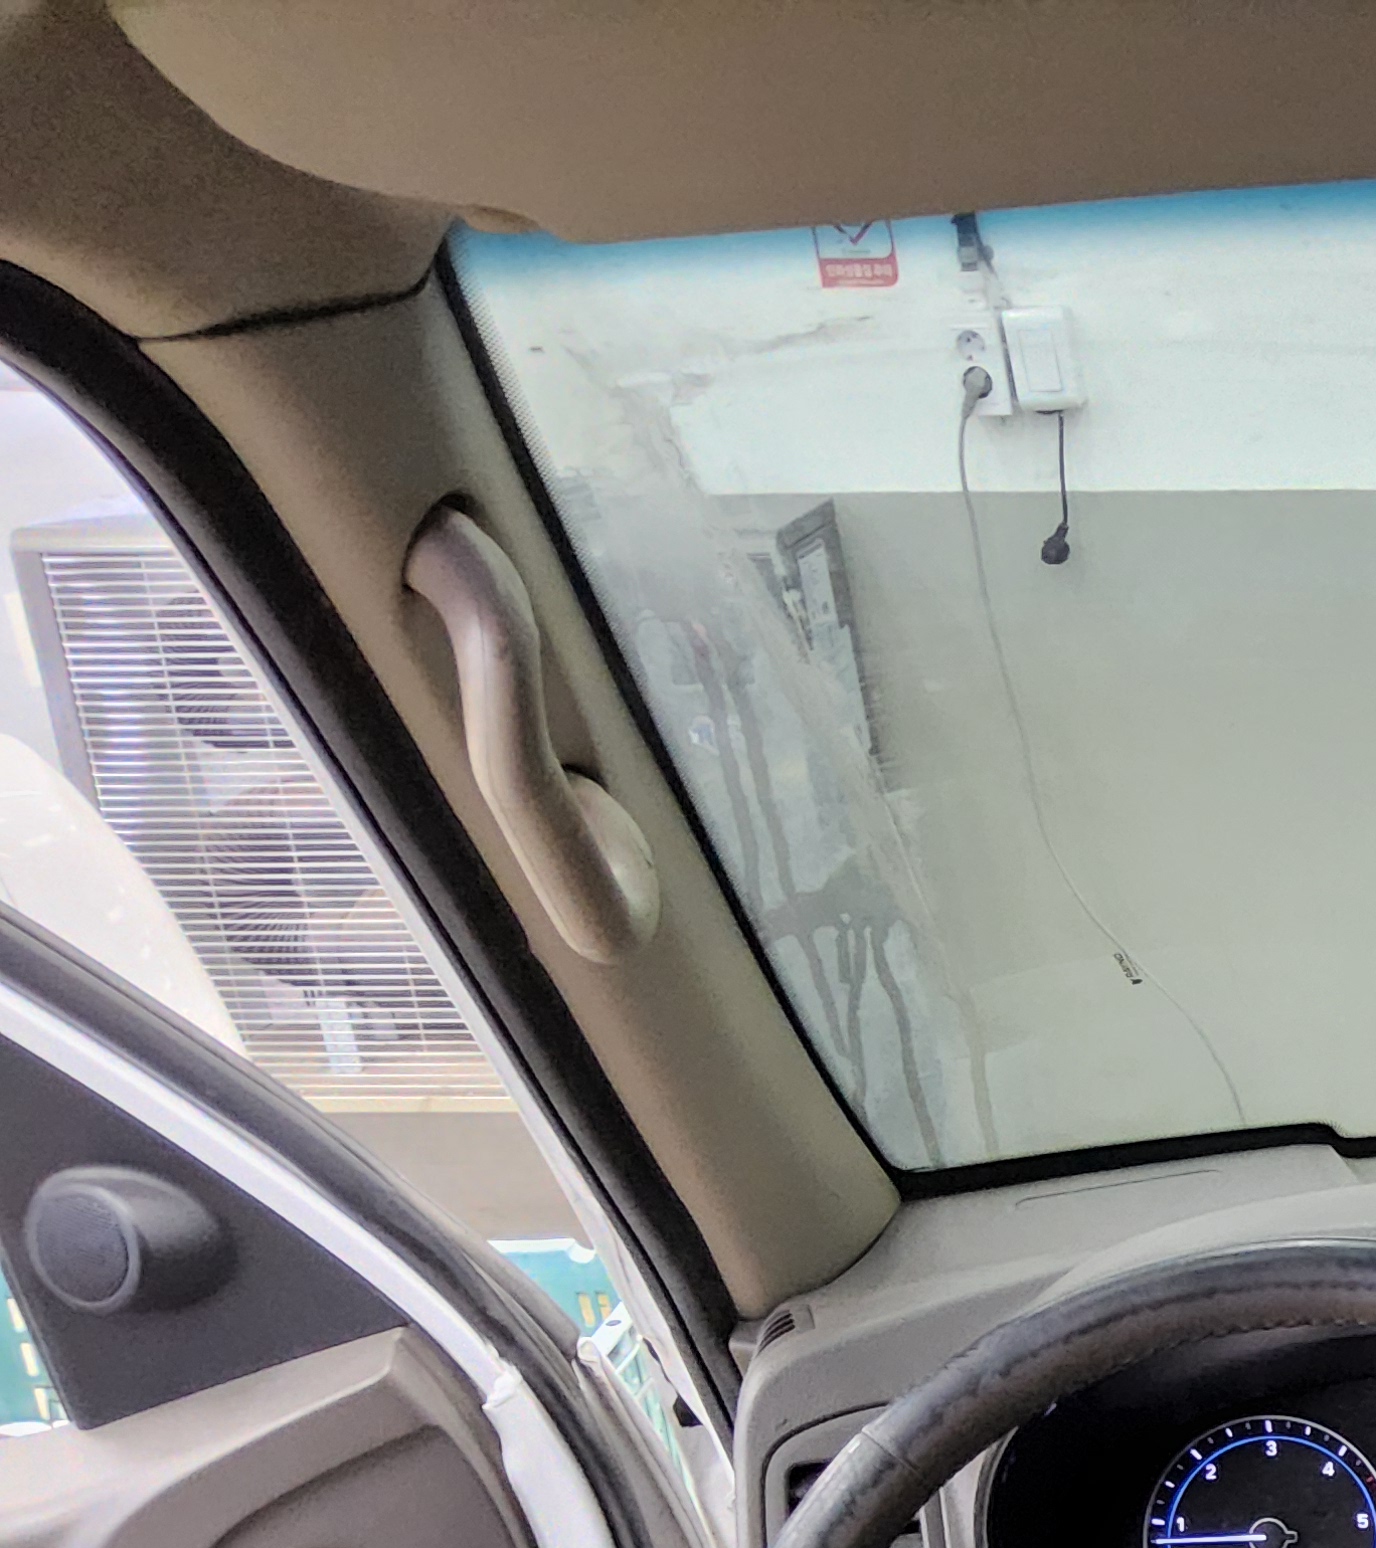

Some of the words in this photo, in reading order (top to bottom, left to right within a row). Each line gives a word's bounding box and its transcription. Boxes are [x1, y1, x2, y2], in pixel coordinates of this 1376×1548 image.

[1265, 1440, 1278, 1457] 3
[1204, 1464, 1217, 1481] 2
[1321, 1461, 1335, 1477] 4
[1176, 1516, 1186, 1532] 1
[1356, 1513, 1370, 1529] 5
